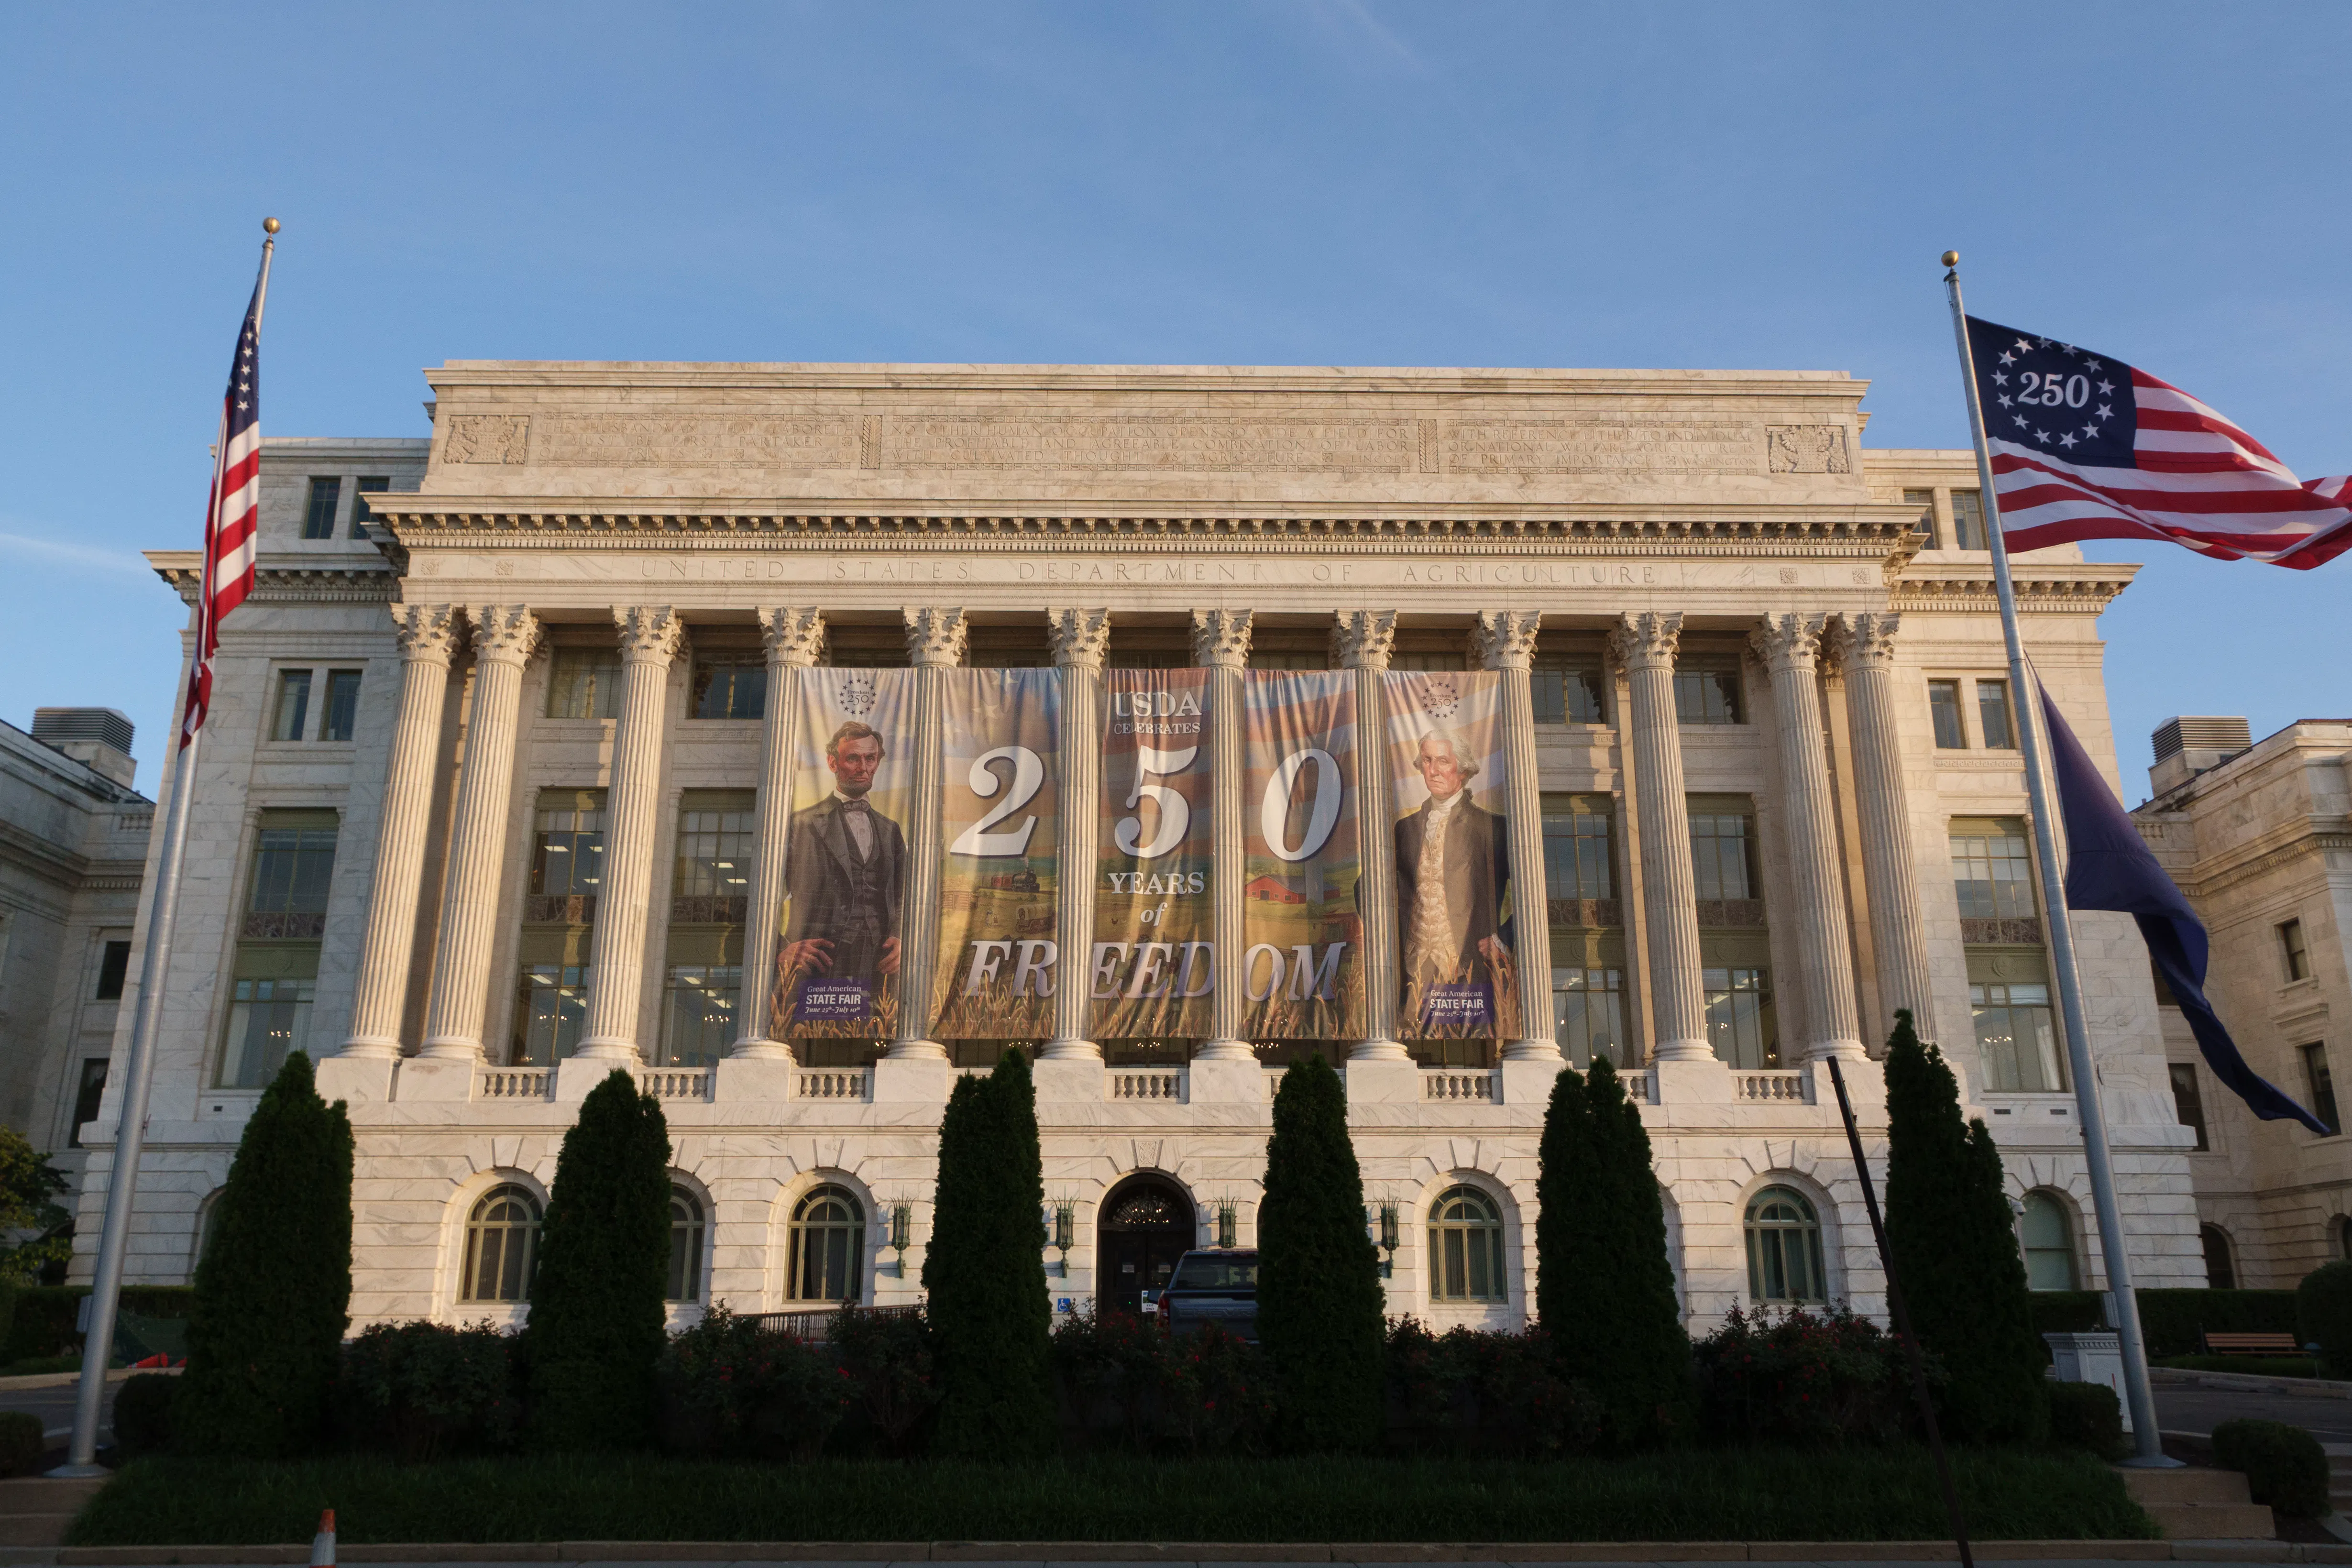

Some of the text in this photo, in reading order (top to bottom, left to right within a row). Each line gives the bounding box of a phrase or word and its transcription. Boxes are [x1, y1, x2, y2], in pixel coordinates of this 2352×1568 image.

[2017, 372, 2090, 408] 250
[541, 422, 853, 435] THE HUSBANDMAN THAT LABORETH
[891, 425, 1409, 439] NO OTHER HUMAN OCCUPATION OPENS SO WIDE A FIELD FOR
[572, 435, 822, 447] MUST BE FIRST PARTAKER
[1448, 429, 1754, 442] WITH REFERENCE EITHER TO INDIVIDUAL
[892, 438, 1409, 451] THE PROFITABLE AND AGREEABLE COMBINATION OF LABOR
[1448, 441, 1756, 453] OR NATIONAL WELFARE AGRICULTURE IS
[539, 447, 850, 460] OF THE FRUITS SAINT PAUL
[891, 450, 1410, 463] WITH CULTIVATED THOUGHT AS AGRICULTURE LINCOLN
[1449, 454, 1757, 466] OF PRIMARY IMPORTANCE WASHINGTON
[640, 559, 1656, 583] UNITED STATES DEPARTMENT OF AGRICULTURE
[847, 694, 869, 706] 250
[1114, 691, 1202, 717] USDA
[1431, 698, 1451, 709] 250
[1114, 722, 1201, 735] CELEBRATES
[1108, 871, 1204, 895] YEARS
[1140, 902, 1168, 926] of
[806, 994, 861, 1005] STATE FAIR
[1429, 998, 1484, 1009] STATE FAIR
